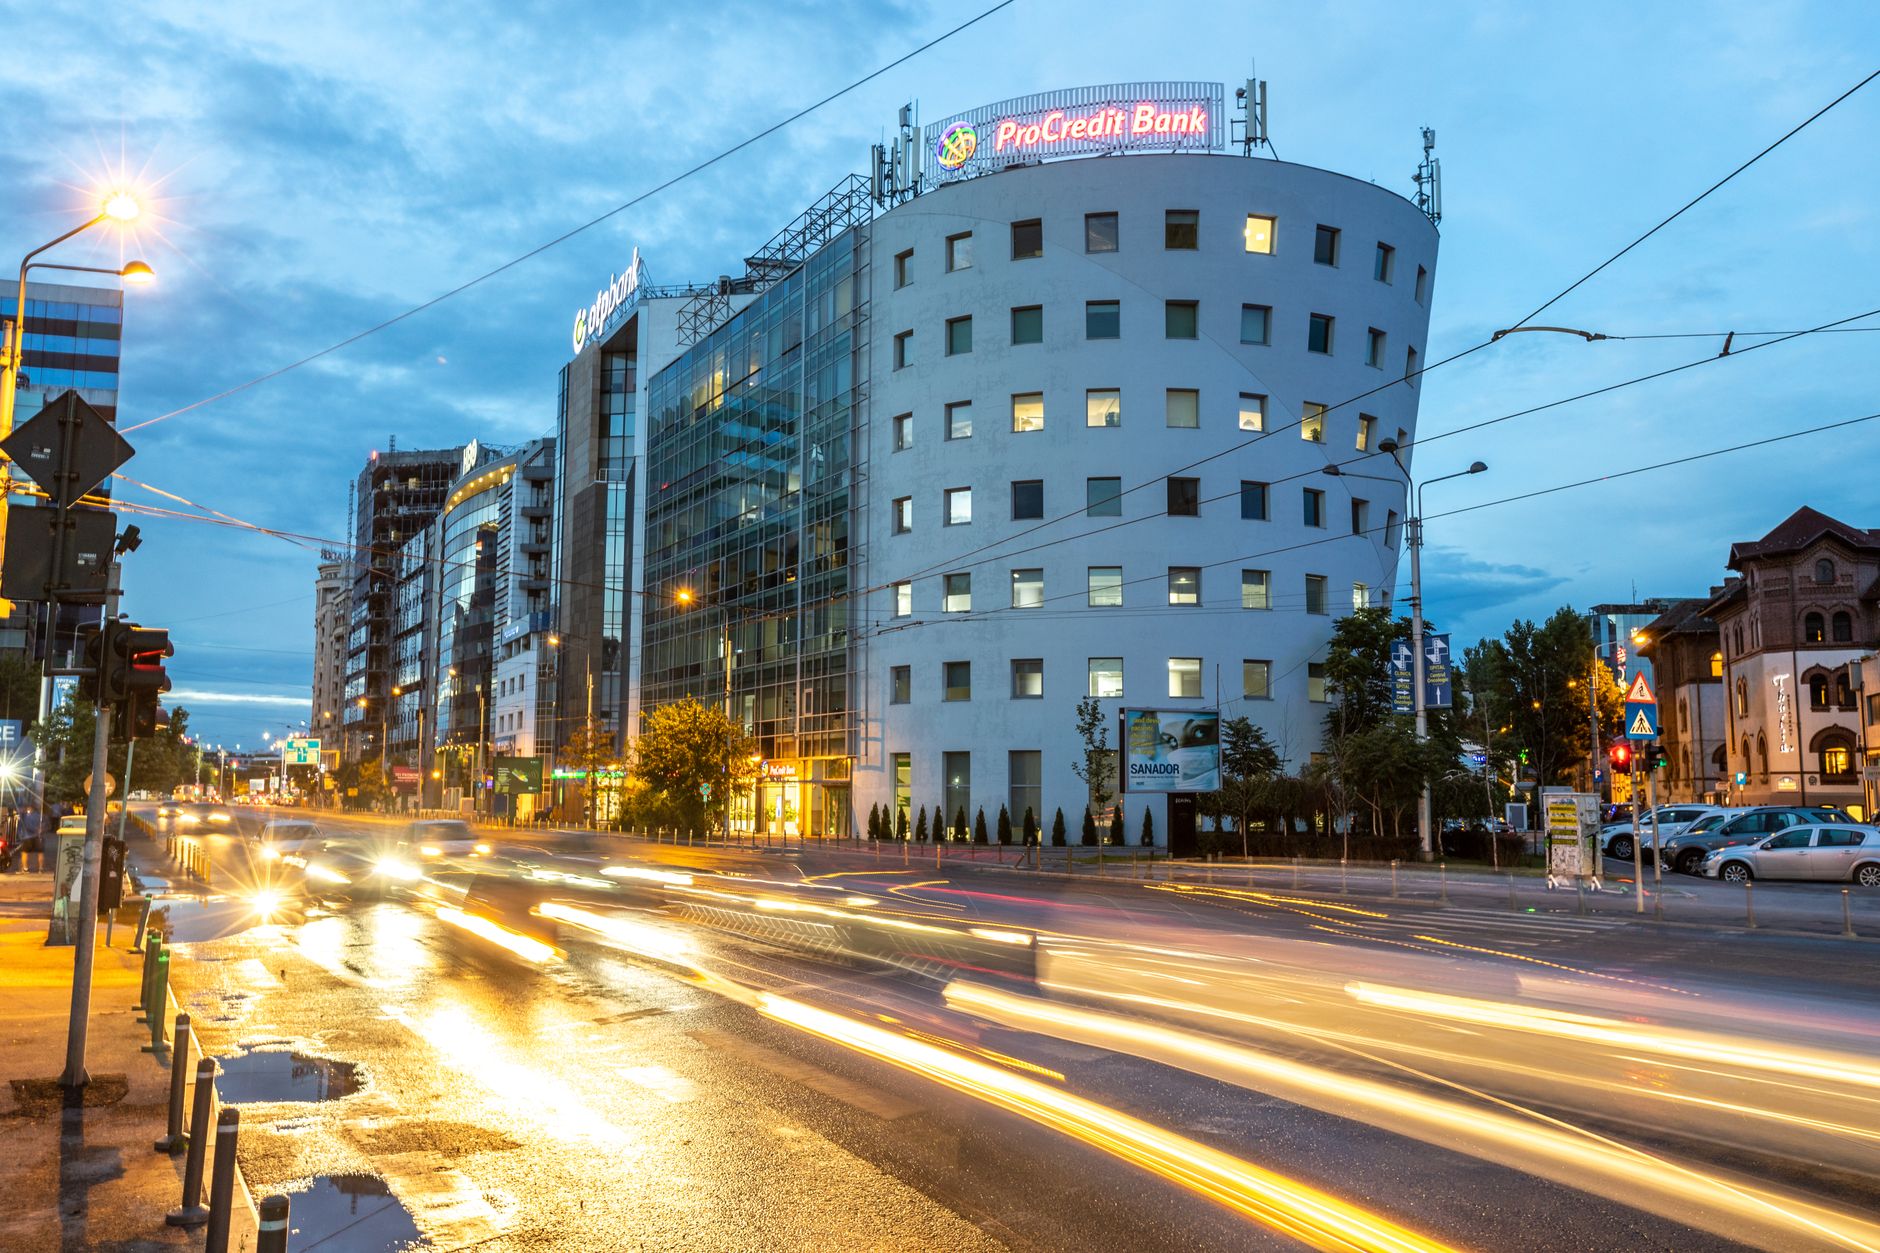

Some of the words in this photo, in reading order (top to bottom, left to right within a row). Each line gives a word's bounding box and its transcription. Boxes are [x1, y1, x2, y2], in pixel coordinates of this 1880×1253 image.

[996, 108, 1125, 151] ProCredit
[1132, 105, 1206, 134] Bank
[0, 725, 15, 741] E
[1130, 763, 1180, 775] SANADOR
[1737, 772, 1745, 783] P
